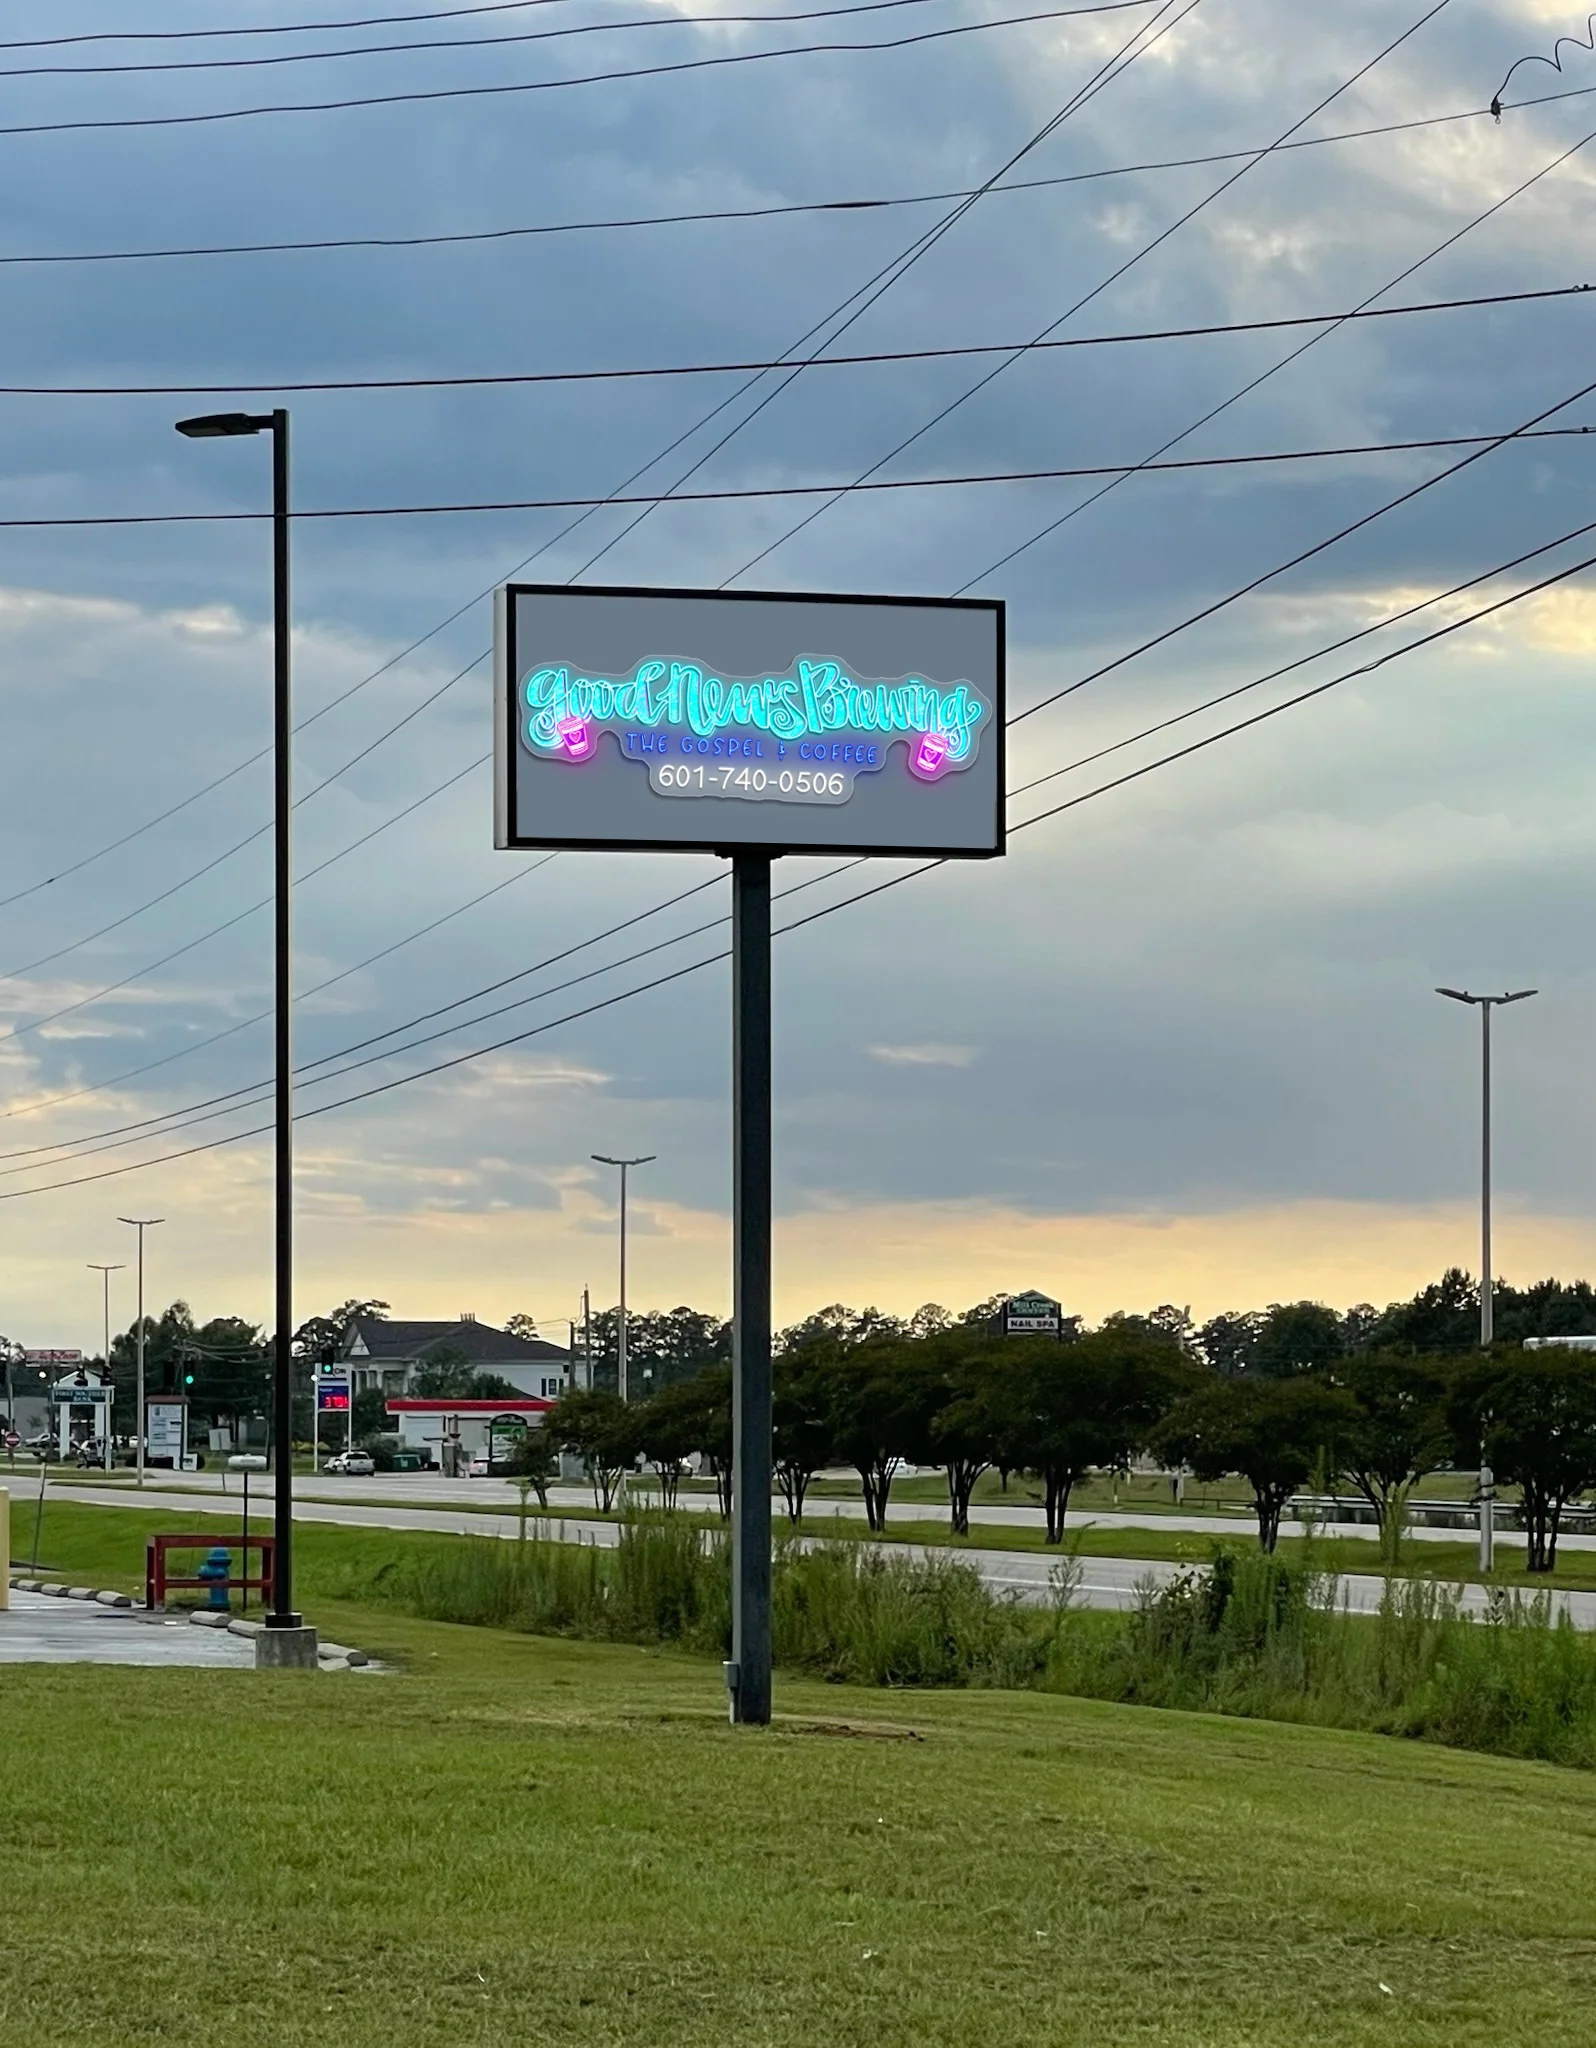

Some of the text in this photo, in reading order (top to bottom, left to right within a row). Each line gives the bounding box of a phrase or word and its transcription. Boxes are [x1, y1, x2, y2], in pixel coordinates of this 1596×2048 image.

[655, 662, 808, 740] News
[798, 660, 984, 761] Brewing
[626, 732, 669, 753] THE
[680, 736, 765, 757] GOSPEL
[800, 742, 878, 764] COFFEE
[658, 763, 845, 796] 601-740-0506
[1010, 1320, 1055, 1328] NAIL SPA
